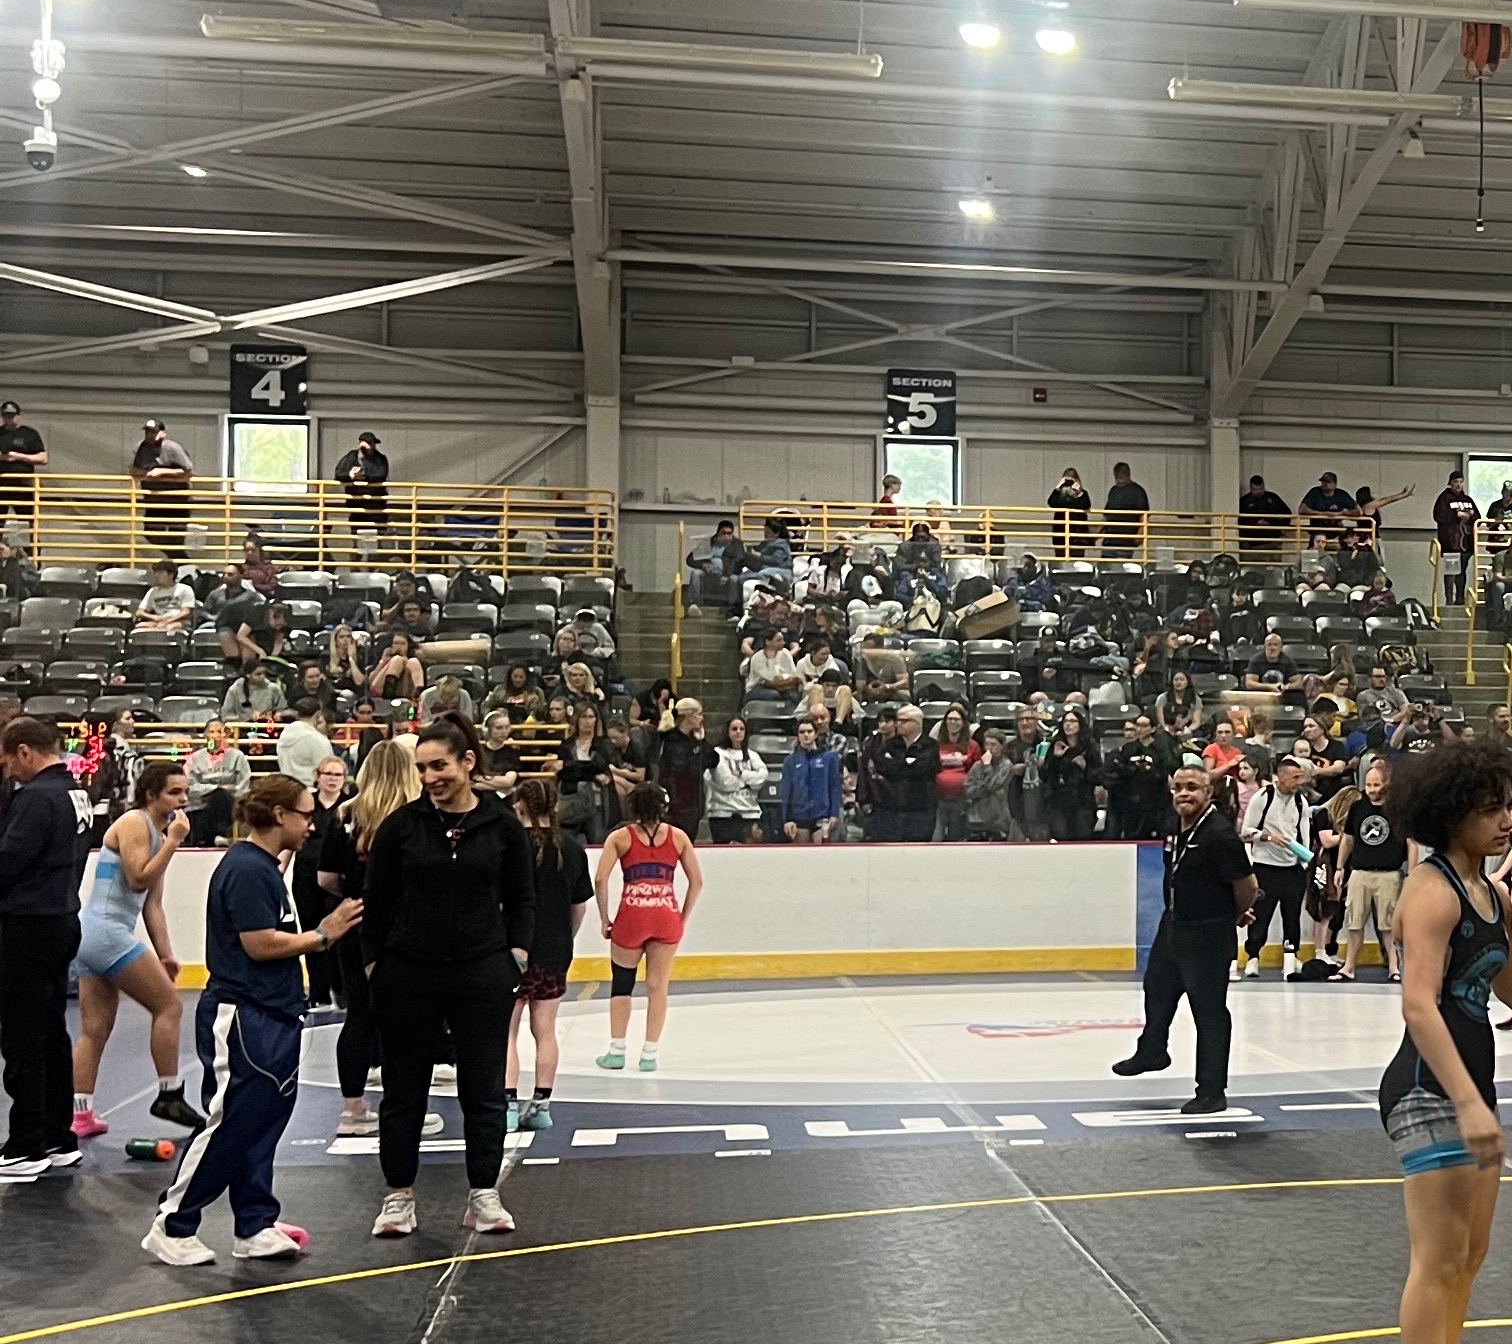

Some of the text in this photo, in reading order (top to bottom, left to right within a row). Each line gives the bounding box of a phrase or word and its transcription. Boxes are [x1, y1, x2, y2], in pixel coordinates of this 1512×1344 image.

[251, 370, 286, 407] 4
[892, 377, 952, 387] SECTION
[907, 392, 937, 428] 5
